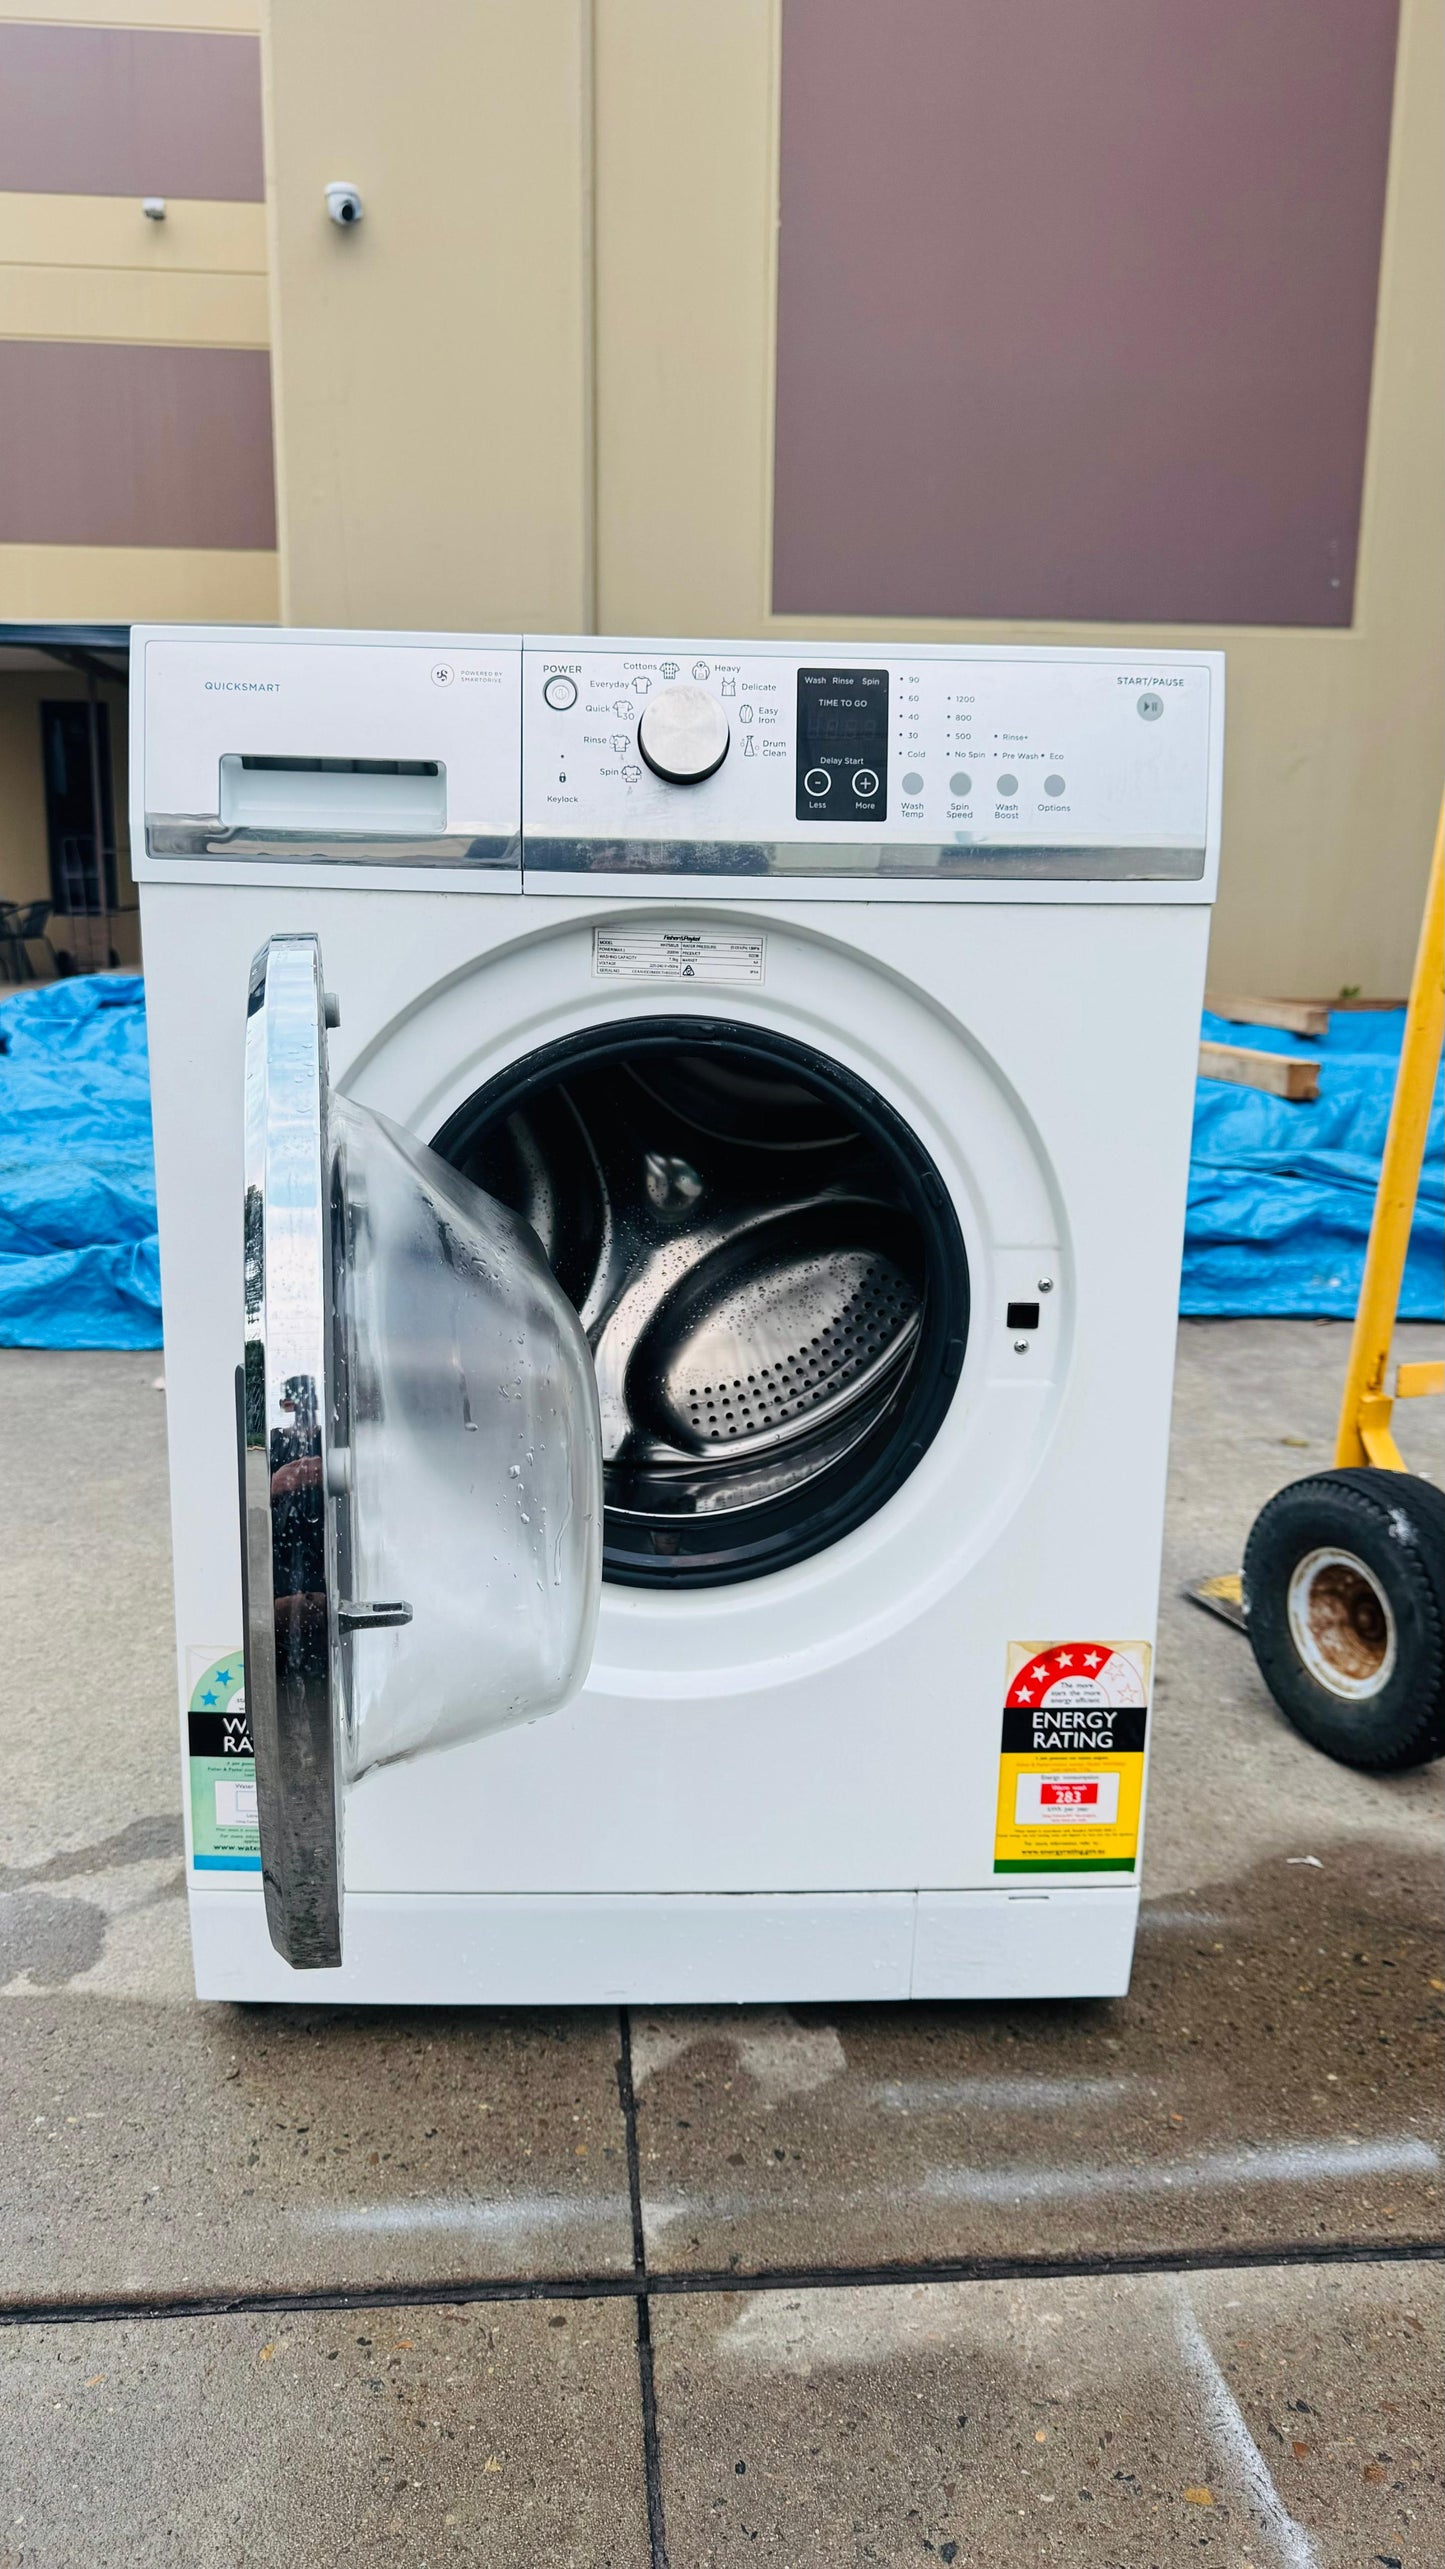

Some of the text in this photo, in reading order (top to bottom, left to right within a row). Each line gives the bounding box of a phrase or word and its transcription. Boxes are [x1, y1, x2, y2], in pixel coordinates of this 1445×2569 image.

[543, 664, 583, 673] POWER
[623, 662, 658, 670] Cottons
[714, 664, 741, 673] Heavy
[804, 676, 880, 686] Wash Rinse Spin
[908, 676, 920, 684] 90
[1116, 677, 1185, 687] START/PAUSE
[204, 681, 281, 692] QUICKSMART
[590, 680, 630, 689] Everyday
[741, 683, 777, 691] Delicate
[818, 699, 839, 707] TIME
[840, 699, 852, 707] TO
[955, 695, 975, 703] 1200
[585, 704, 611, 713] Quick
[758, 707, 779, 715] Easy
[621, 712, 635, 720] 30
[907, 713, 919, 721] 40
[907, 731, 919, 739] 30
[955, 732, 972, 740] 500
[1002, 733, 1028, 741] Rinse+
[583, 736, 607, 744] Rinse
[954, 751, 986, 760] No Spin
[1002, 752, 1016, 760] Pre
[820, 756, 864, 765] Delay Start
[599, 768, 619, 776] Spin
[546, 795, 579, 804] Keylock
[808, 801, 827, 809] Less
[855, 801, 876, 809] More
[900, 802, 924, 810] Wash
[950, 802, 970, 812] Spin
[995, 803, 1019, 811] Wash
[1037, 804, 1072, 812] Options
[901, 810, 924, 819] Temp
[946, 811, 974, 819] Speed
[994, 811, 1019, 819] Boost
[1032, 1711, 1118, 1729] ENERGY
[1033, 1731, 1114, 1749] RATING
[223, 1736, 254, 1753] RA
[1055, 1791, 1082, 1804] 283
